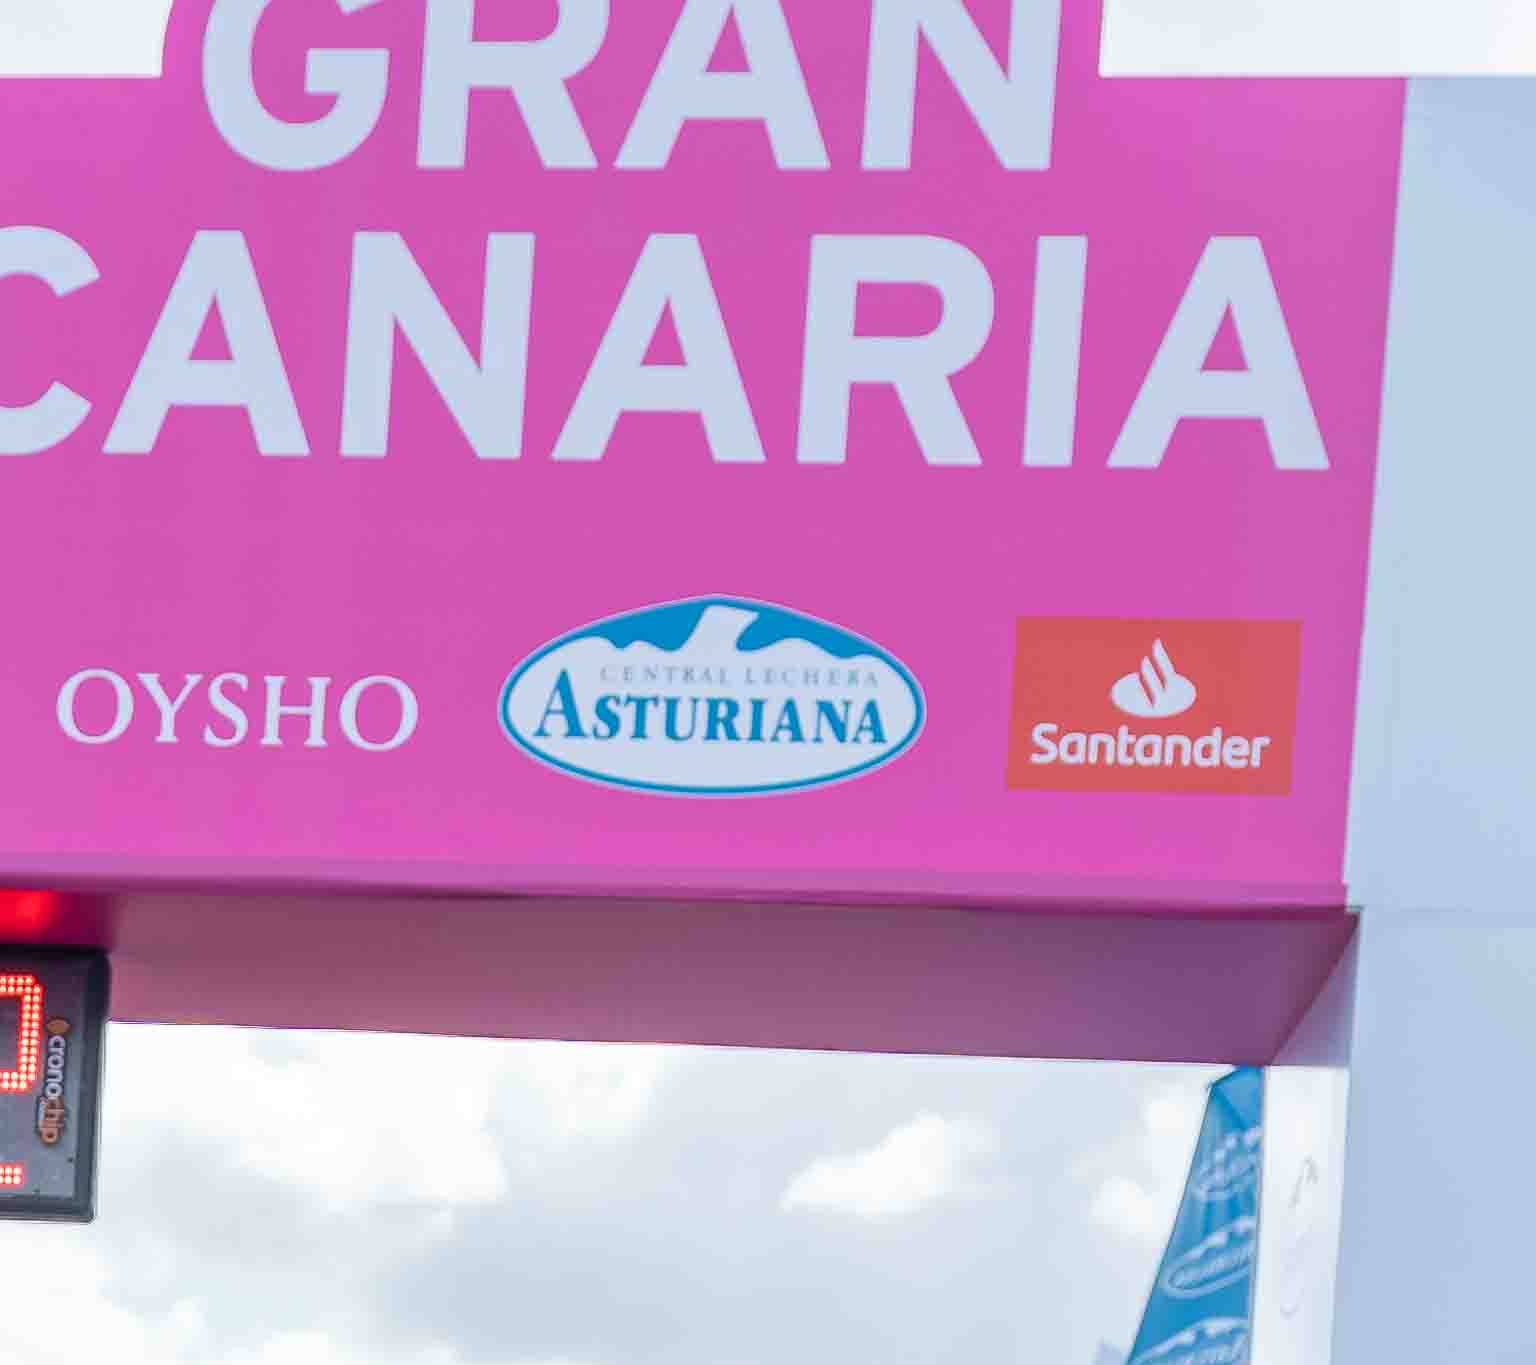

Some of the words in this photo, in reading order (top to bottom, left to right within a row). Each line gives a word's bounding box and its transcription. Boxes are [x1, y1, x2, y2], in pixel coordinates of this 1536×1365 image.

[202, 0, 1063, 171] GRAN
[56, 667, 419, 751] OYSHO
[534, 669, 889, 746] ASTURIANA
[1030, 723, 1271, 770] Santander
